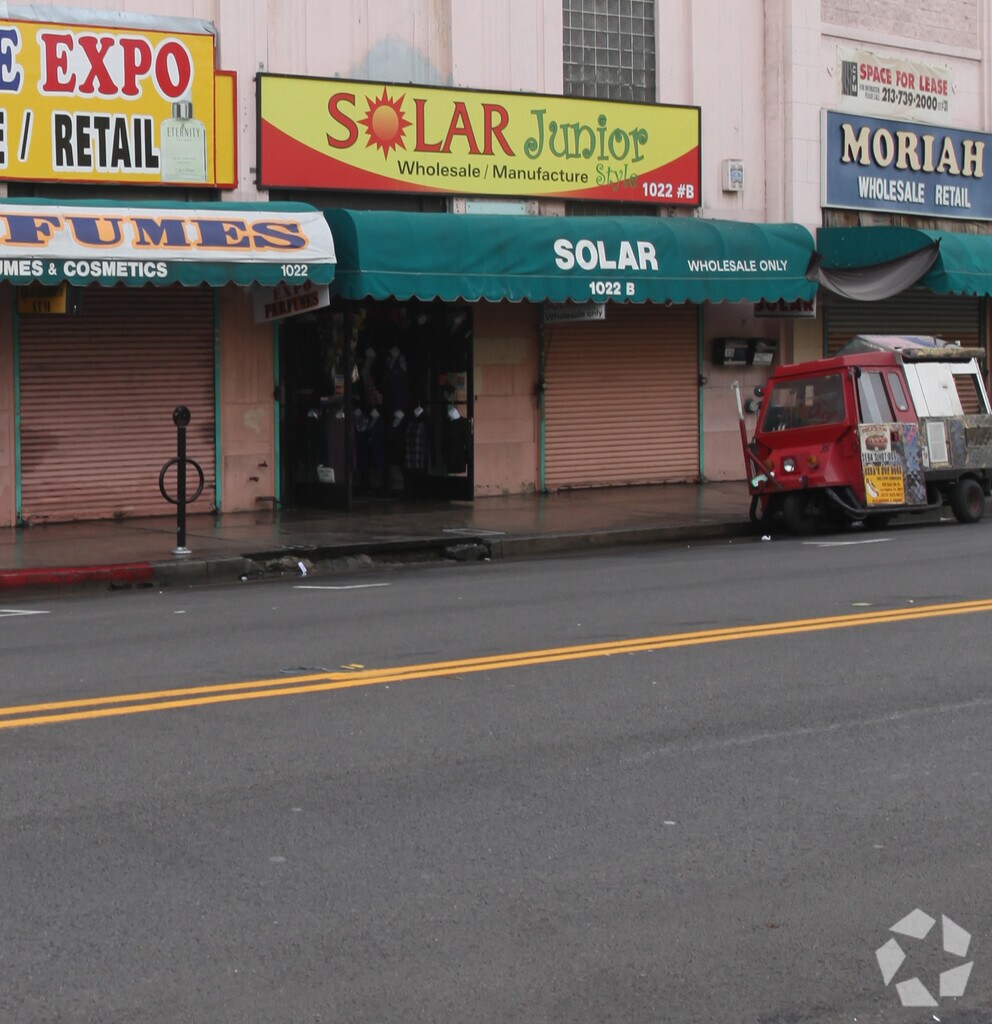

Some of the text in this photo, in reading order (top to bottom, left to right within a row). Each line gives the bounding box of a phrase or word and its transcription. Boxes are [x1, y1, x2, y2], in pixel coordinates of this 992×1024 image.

[41, 33, 191, 98] EXPO
[859, 63, 948, 96] SPACE FOR LEASE
[20, 112, 31, 159] /
[55, 114, 158, 168] RETAIL
[167, 125, 200, 138] ETERNITY
[524, 109, 648, 163] Junior
[841, 123, 985, 178] MORIAH
[398, 160, 481, 178] Wholesale
[493, 164, 589, 183] Manufacture
[595, 163, 639, 192] Style
[642, 182, 694, 199] 1022 #B
[859, 176, 971, 208] WHOLESALE RETAIL
[48, 264, 57, 275] &
[63, 260, 168, 278] COSMETICS
[554, 238, 658, 271] SOLAR
[688, 259, 788, 272] WHOLESALE ONLY
[281, 264, 308, 277] 1022
[589, 281, 635, 296] 1022 B
